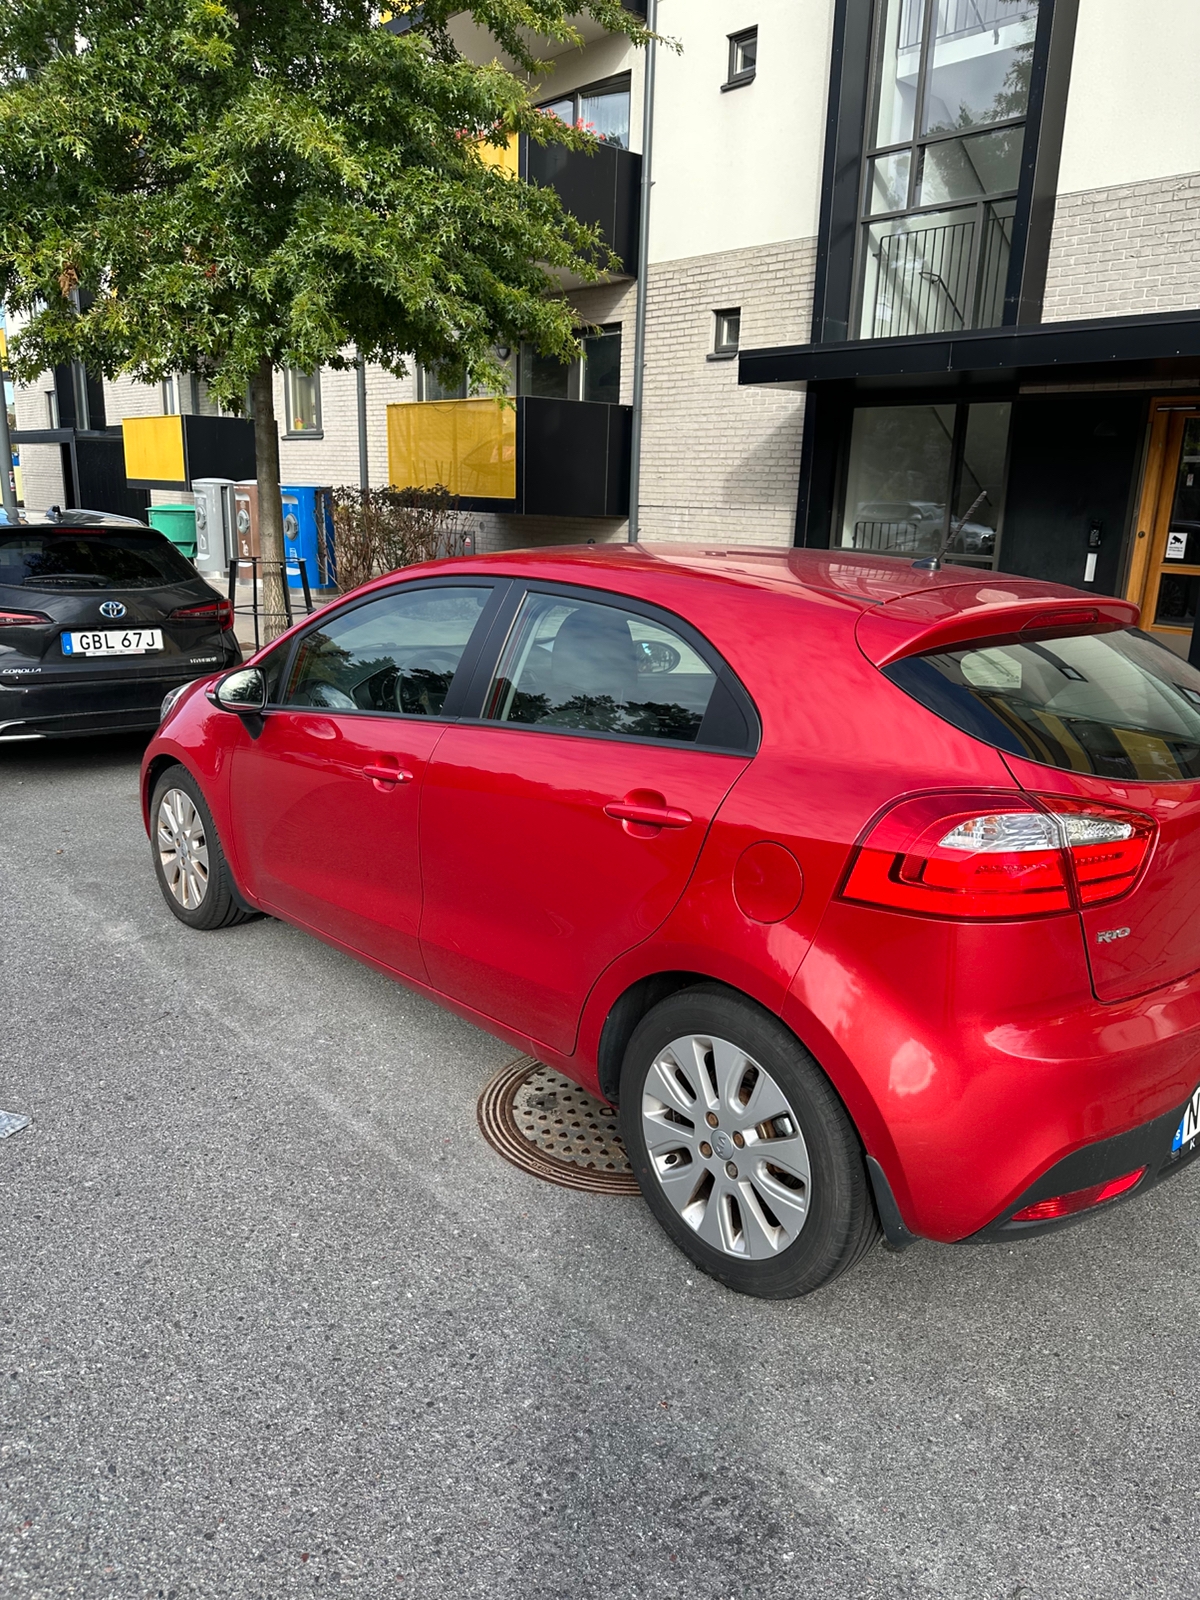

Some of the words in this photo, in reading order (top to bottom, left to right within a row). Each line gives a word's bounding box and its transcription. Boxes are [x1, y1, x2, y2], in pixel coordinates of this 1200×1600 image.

[79, 633, 115, 651] GBL
[121, 631, 155, 649] 67J
[1096, 926, 1131, 944] RIO
